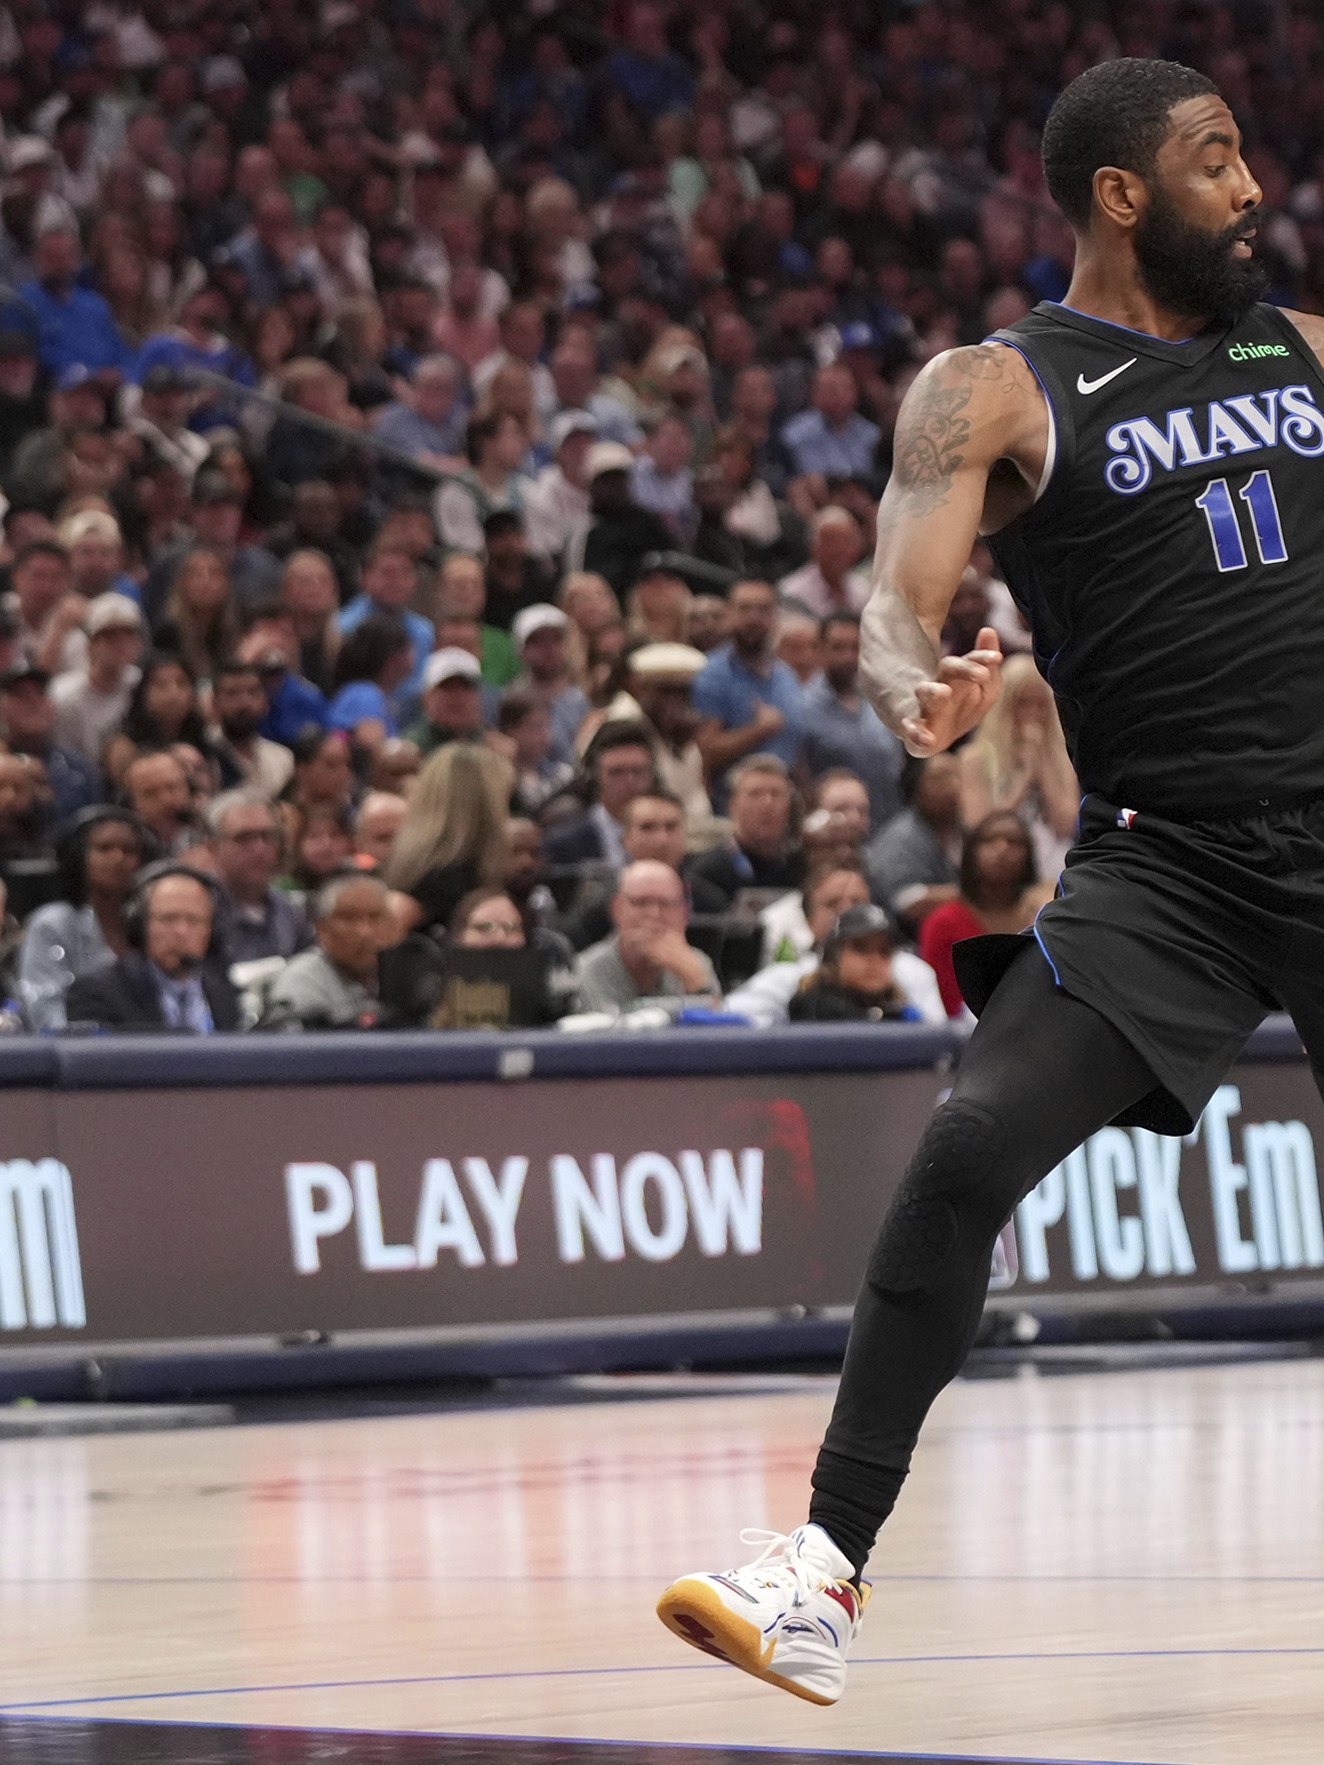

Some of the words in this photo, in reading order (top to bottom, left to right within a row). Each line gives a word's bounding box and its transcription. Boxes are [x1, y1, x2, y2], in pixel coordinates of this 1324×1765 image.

[1228, 341, 1291, 362] chime
[1195, 469, 1289, 573] 11
[285, 1155, 529, 1275] PLAY
[550, 1147, 765, 1263] NOW
